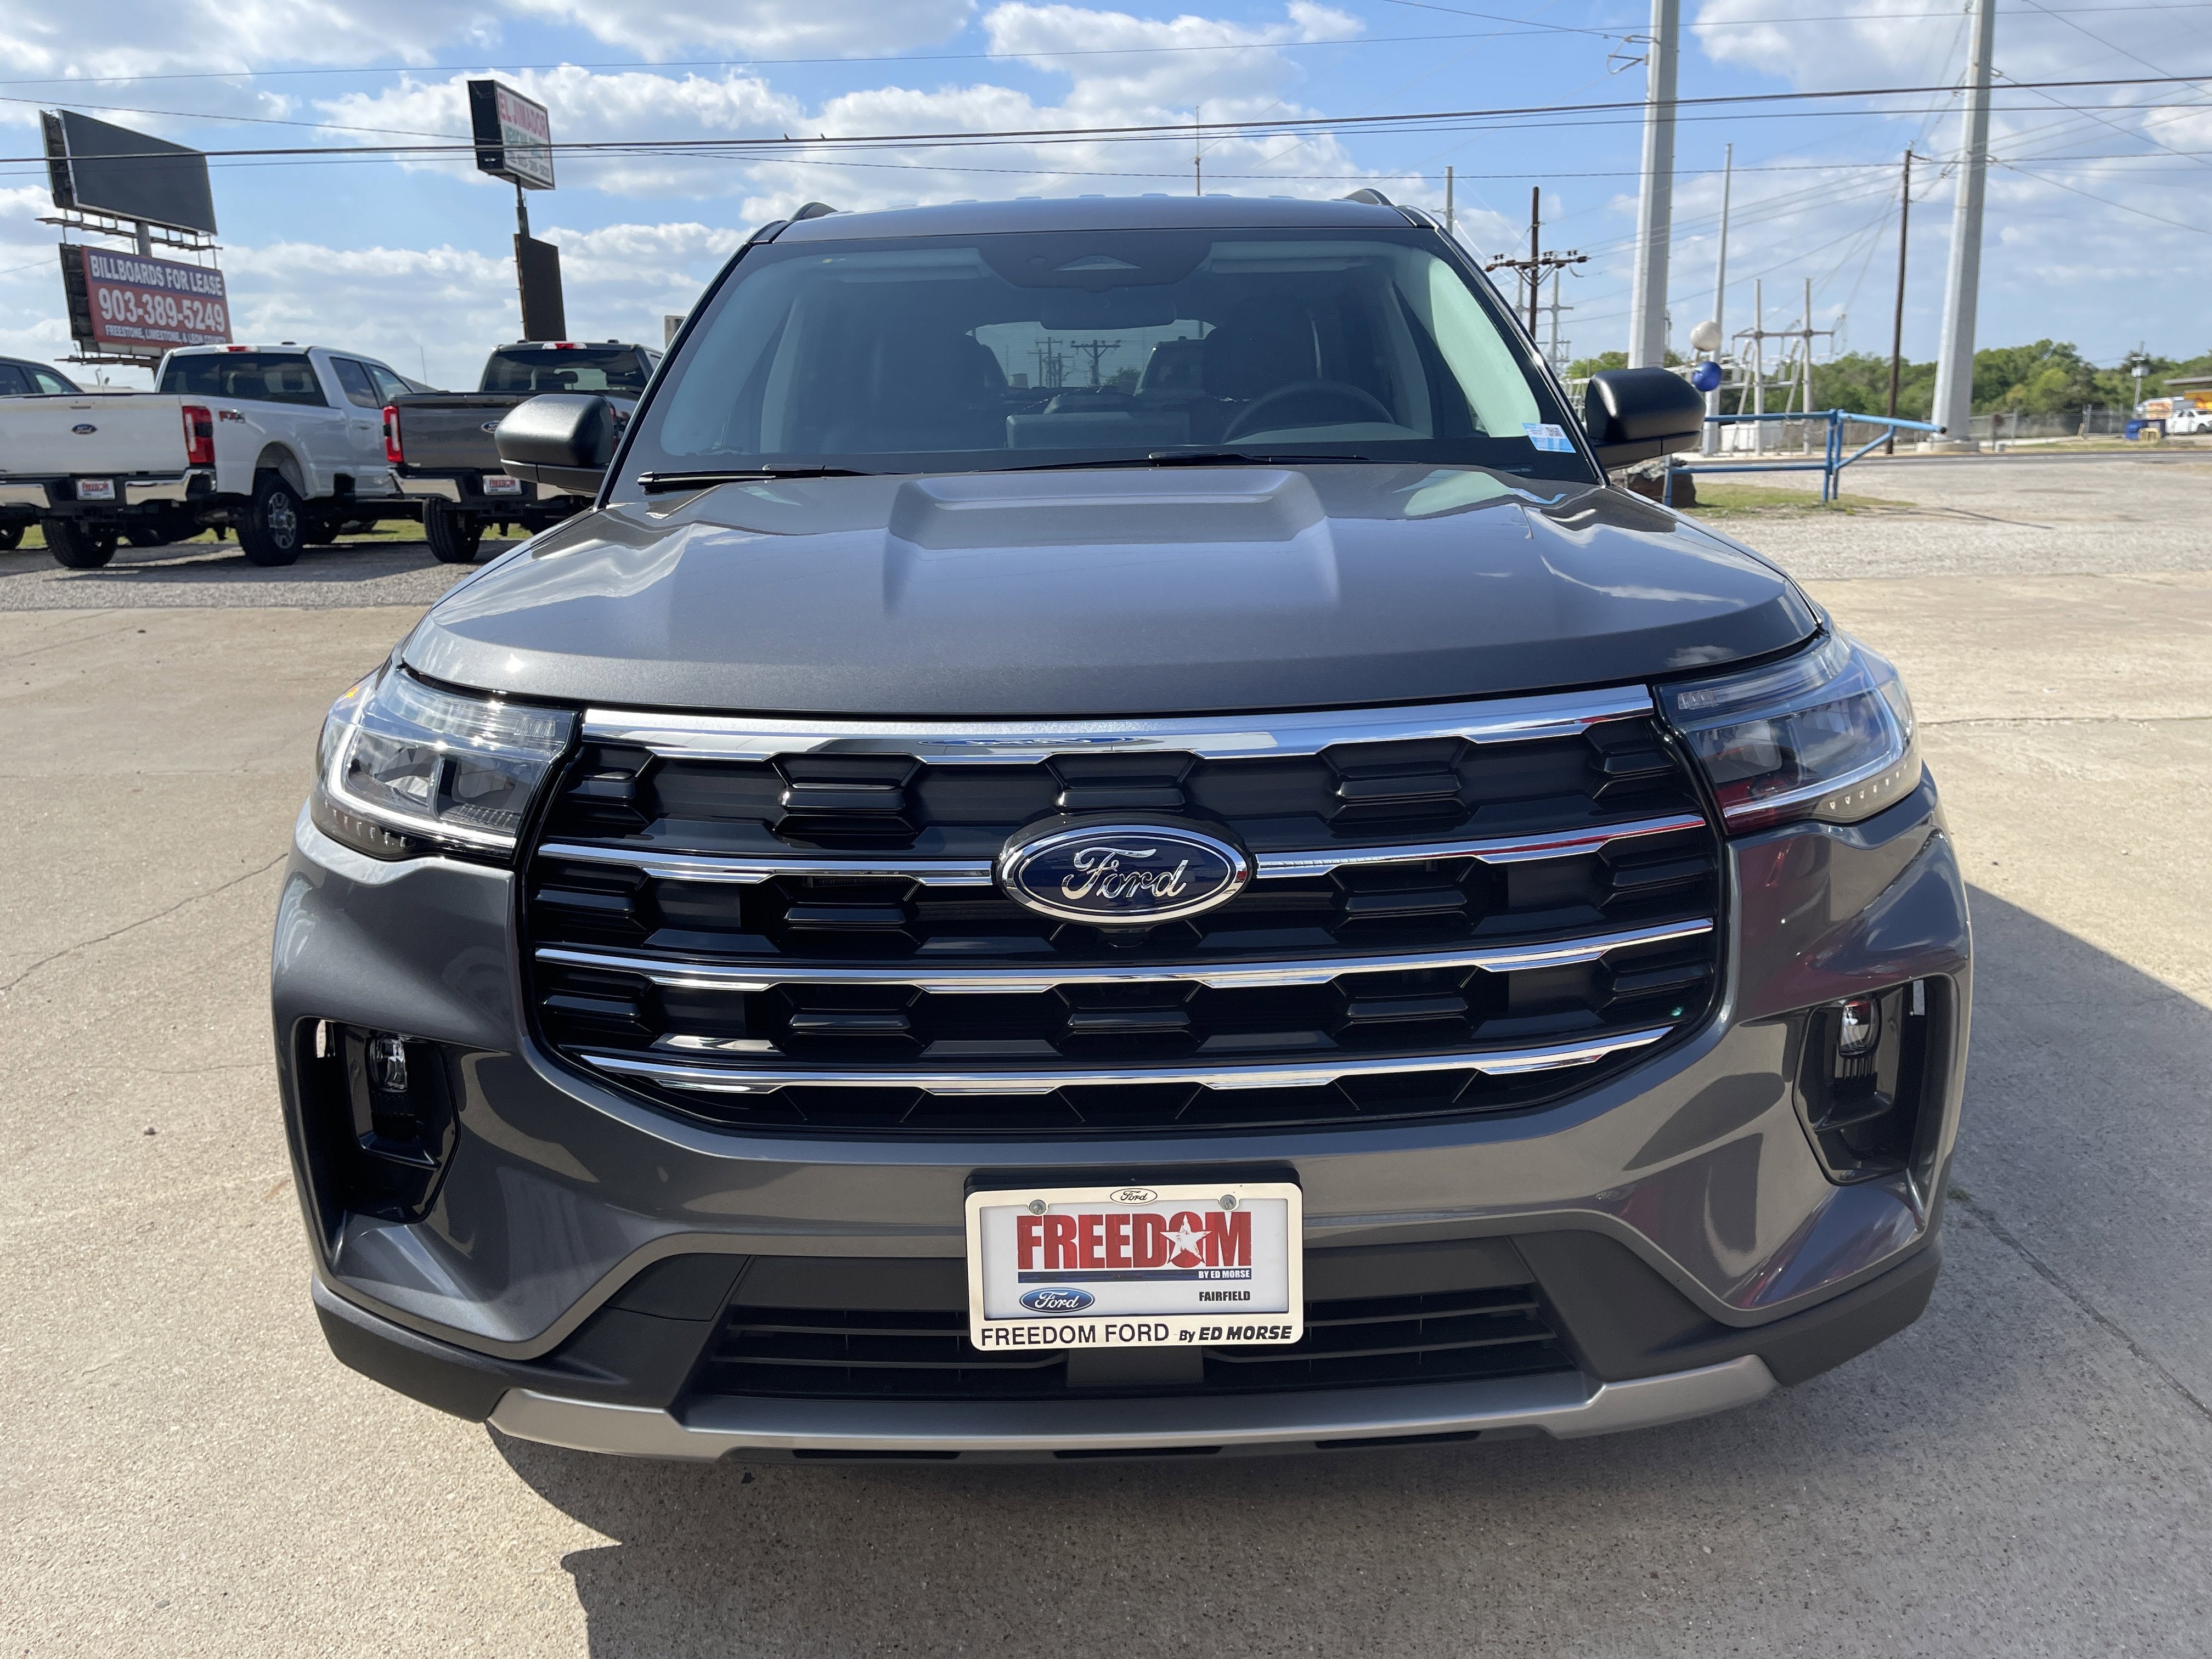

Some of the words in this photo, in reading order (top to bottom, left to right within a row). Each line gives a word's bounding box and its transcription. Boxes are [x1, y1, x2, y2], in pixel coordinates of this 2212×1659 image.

[90, 255, 165, 287] BILLBOARDS
[165, 267, 189, 291] FOR
[190, 272, 223, 296] LEASE
[98, 287, 225, 333] 903-389-5249
[1062, 847, 1189, 900] Ford
[1120, 1190, 1148, 1201] Ford
[1017, 1211, 1252, 1270] FREEDOM
[1198, 1271, 1209, 1279] BY
[1210, 1270, 1221, 1279] ED
[1222, 1269, 1250, 1278] MORSE
[1034, 1291, 1080, 1308] Ford
[1199, 1291, 1251, 1301] FAIRFIELD
[981, 1324, 1096, 1346] FREEDOM
[1105, 1323, 1169, 1342] FORD
[1180, 1330, 1195, 1342] By
[1199, 1327, 1222, 1340] ED
[1226, 1325, 1293, 1340] MORSE
